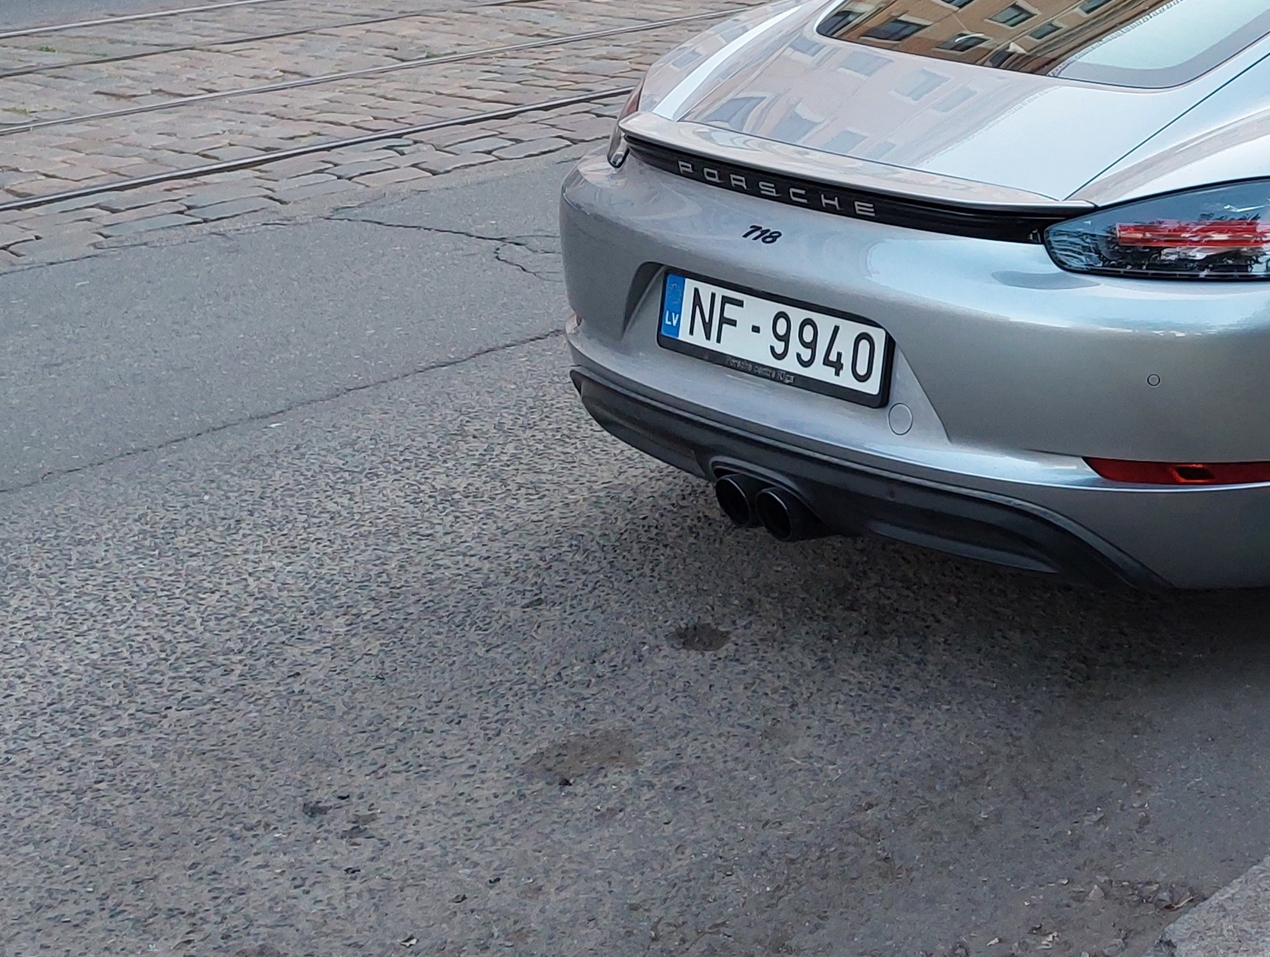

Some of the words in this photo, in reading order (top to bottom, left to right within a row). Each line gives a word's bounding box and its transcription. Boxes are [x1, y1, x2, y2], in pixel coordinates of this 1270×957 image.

[678, 160, 876, 217] PORSCHE
[741, 224, 783, 244] 718
[664, 310, 679, 327] LV
